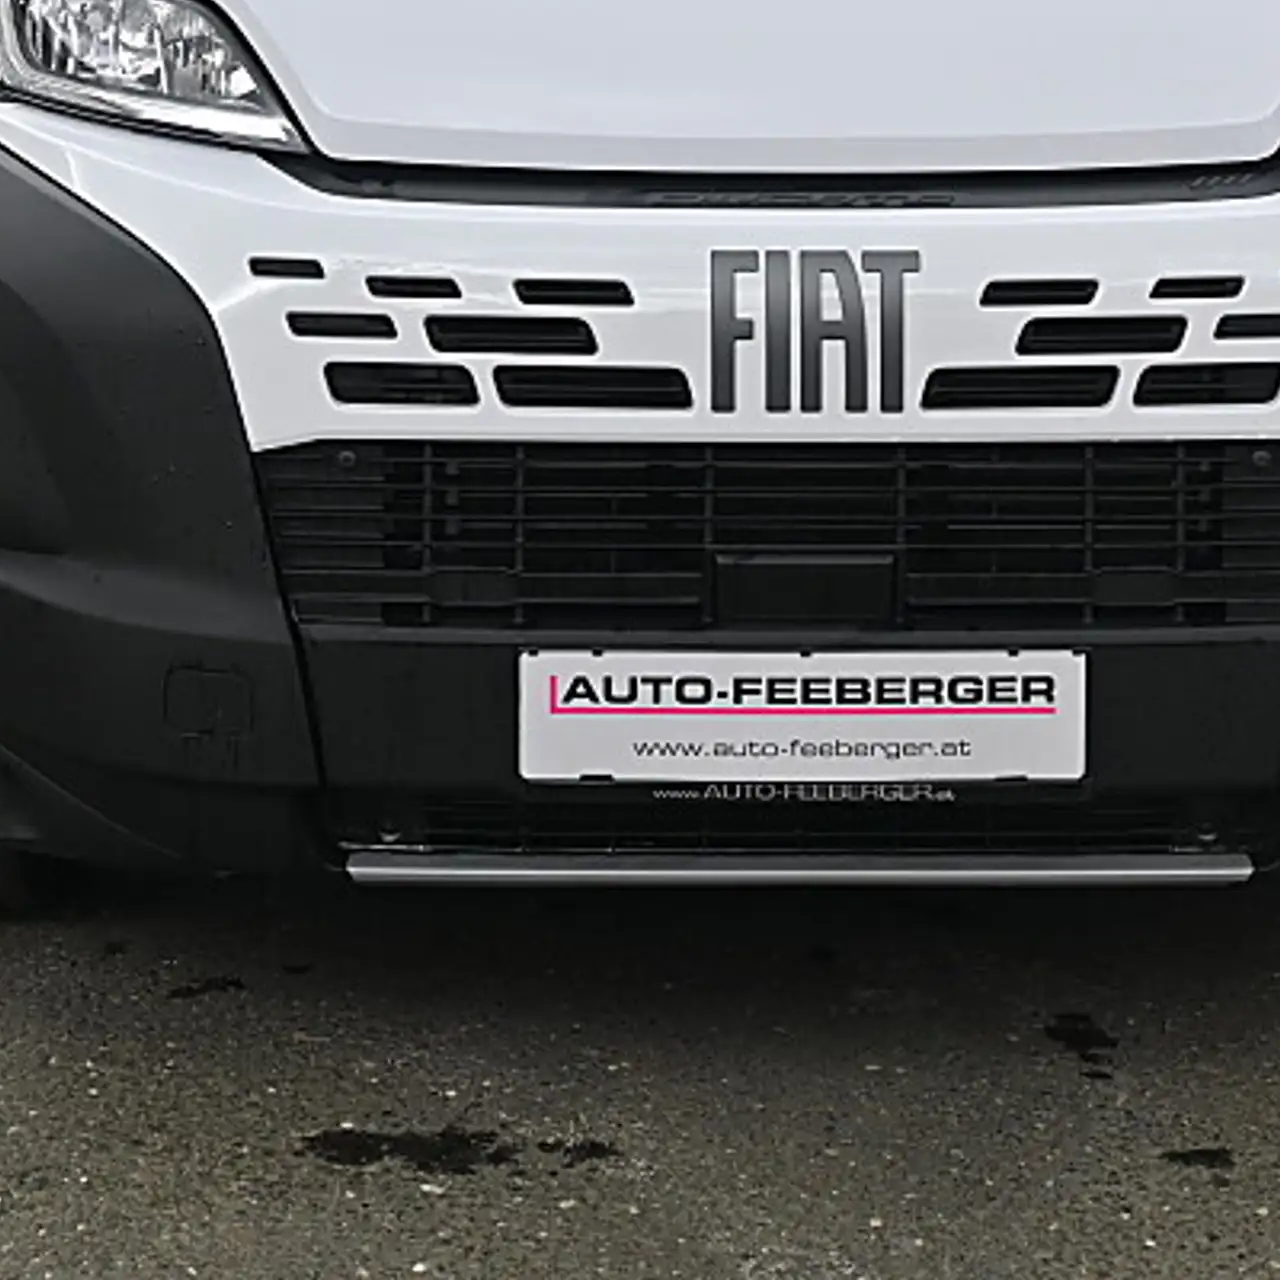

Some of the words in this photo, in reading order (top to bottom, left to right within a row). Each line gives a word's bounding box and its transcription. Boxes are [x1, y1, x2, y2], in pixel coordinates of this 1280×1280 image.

[710, 249, 920, 413] FIAT
[561, 674, 1057, 705] AUTO-FEEBERGER
[632, 738, 972, 761] www.auto-feeberger.at
